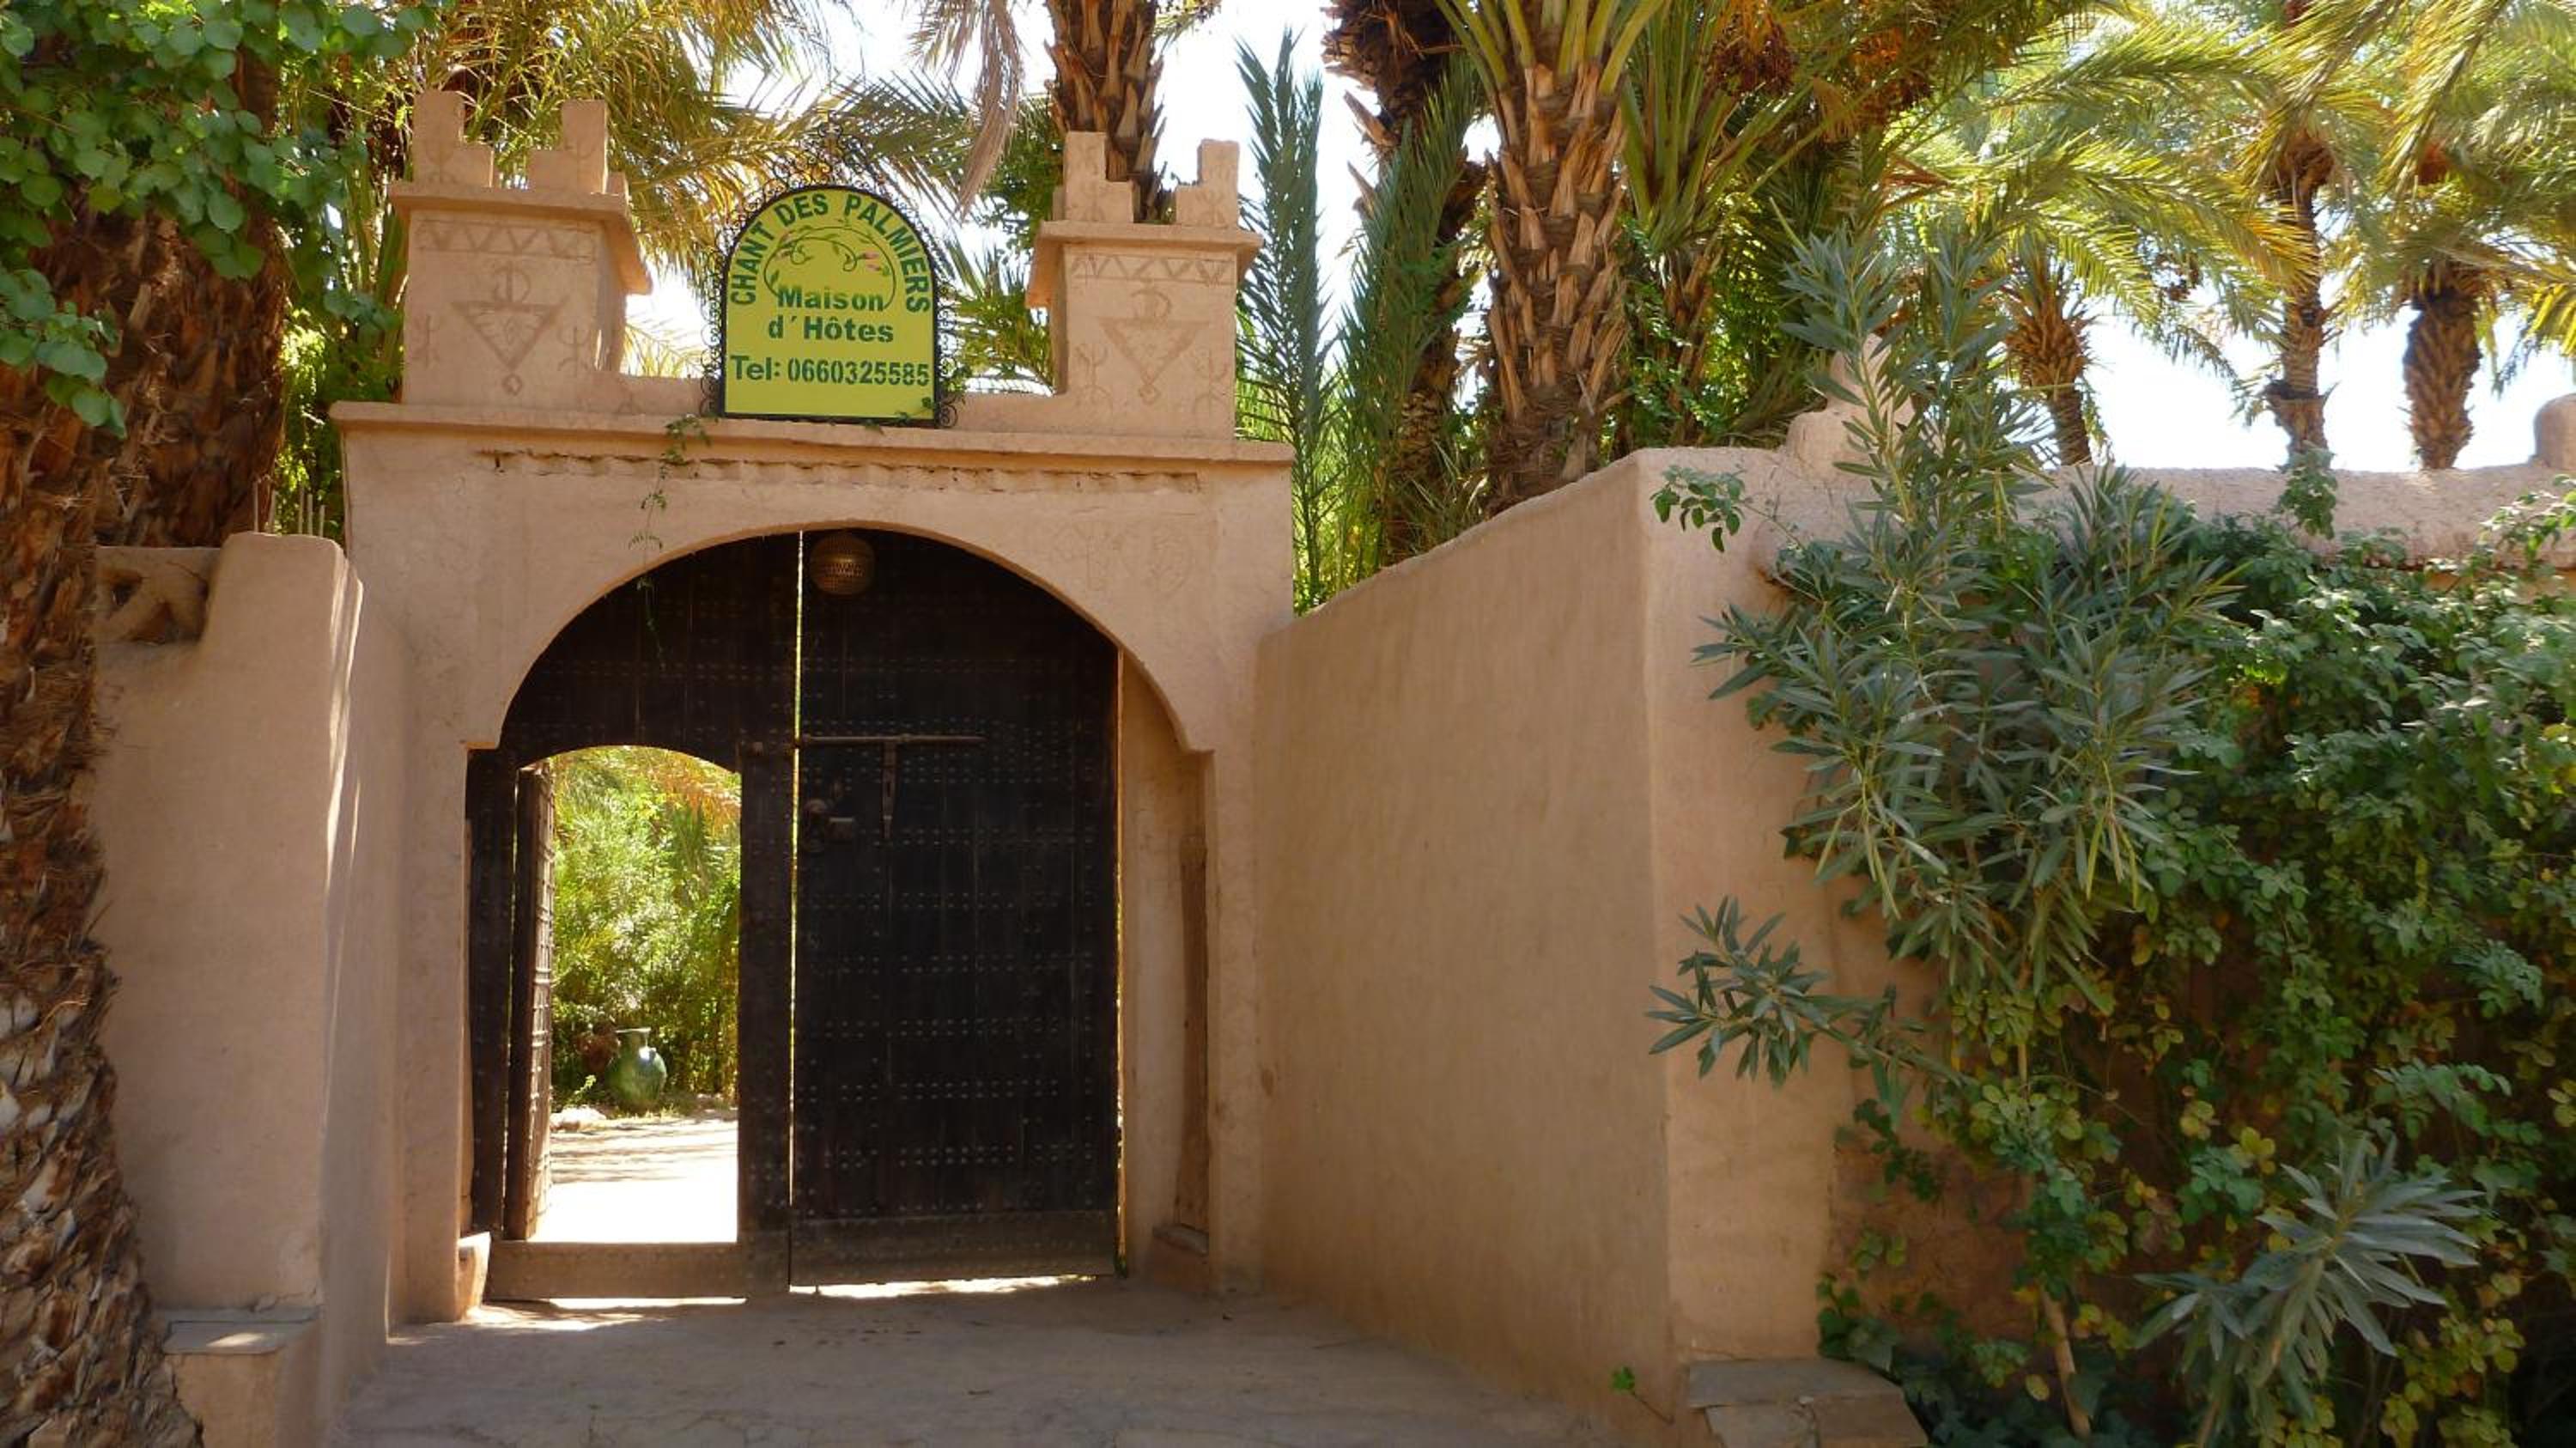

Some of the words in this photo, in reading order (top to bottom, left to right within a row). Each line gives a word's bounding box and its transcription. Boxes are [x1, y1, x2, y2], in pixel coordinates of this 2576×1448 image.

[730, 221, 775, 305] CHANT
[775, 193, 829, 227] DES
[844, 194, 930, 313] PALMIERS
[777, 285, 884, 311] Maison
[731, 355, 780, 380] Tel:
[787, 357, 930, 386] 0660325585
